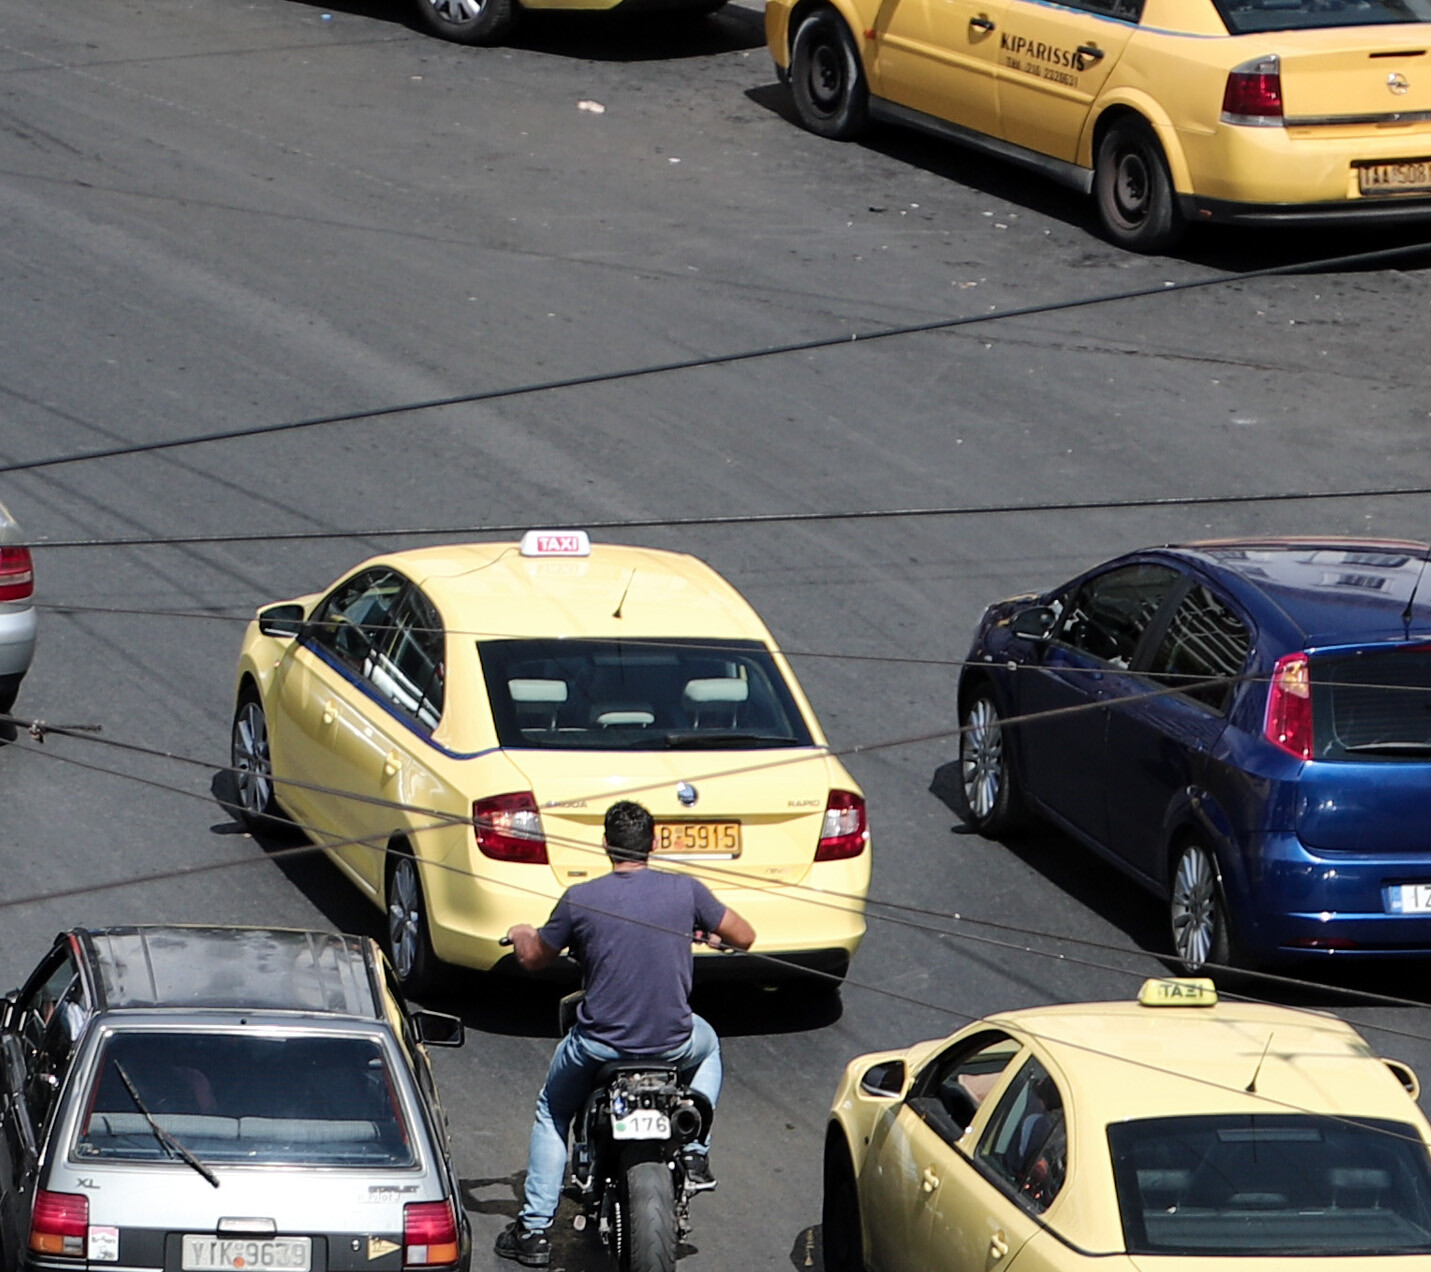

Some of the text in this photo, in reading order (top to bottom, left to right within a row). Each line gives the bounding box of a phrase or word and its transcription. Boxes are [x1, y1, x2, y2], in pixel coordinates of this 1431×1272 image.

[539, 537, 578, 551] TAXI
[660, 825, 736, 849] B-5915
[630, 1117, 667, 1133] 176
[76, 1177, 101, 1189] XL
